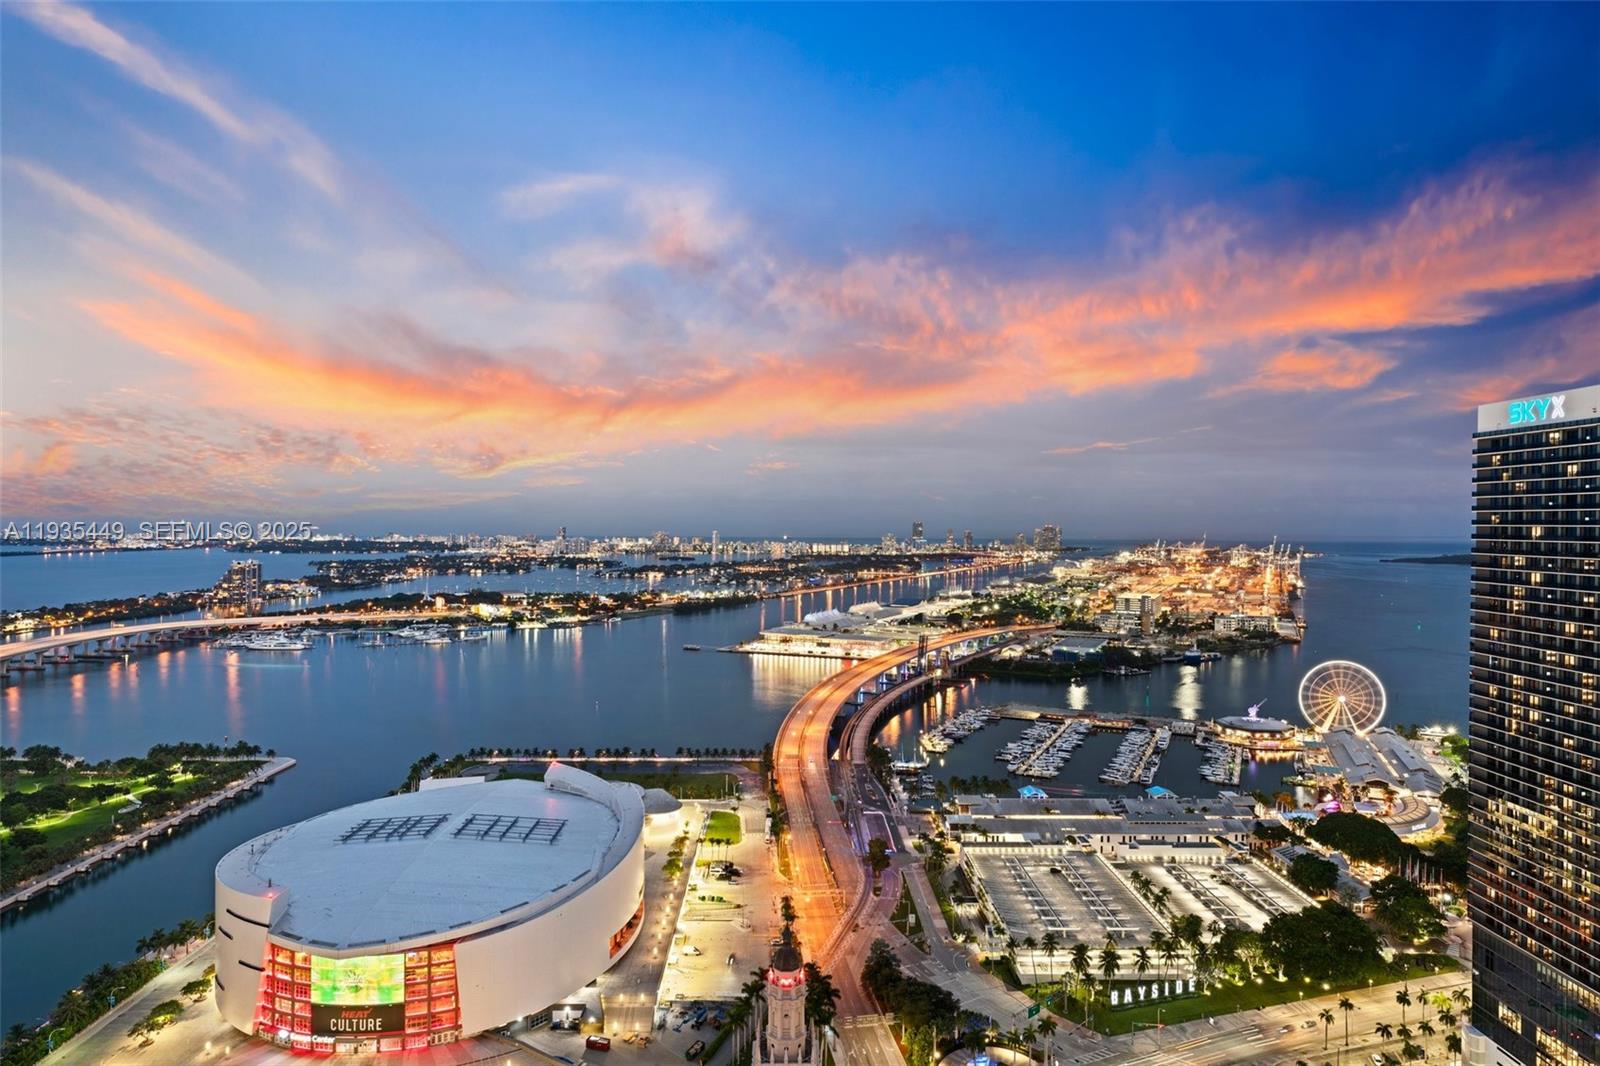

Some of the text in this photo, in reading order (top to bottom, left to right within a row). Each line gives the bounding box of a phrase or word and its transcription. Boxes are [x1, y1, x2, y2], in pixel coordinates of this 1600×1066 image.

[1508, 394, 1566, 425] SKYX
[1110, 976, 1197, 1006] BAYSIDE
[341, 1008, 373, 1018] HEAT
[330, 1018, 383, 1032] CULTURE
